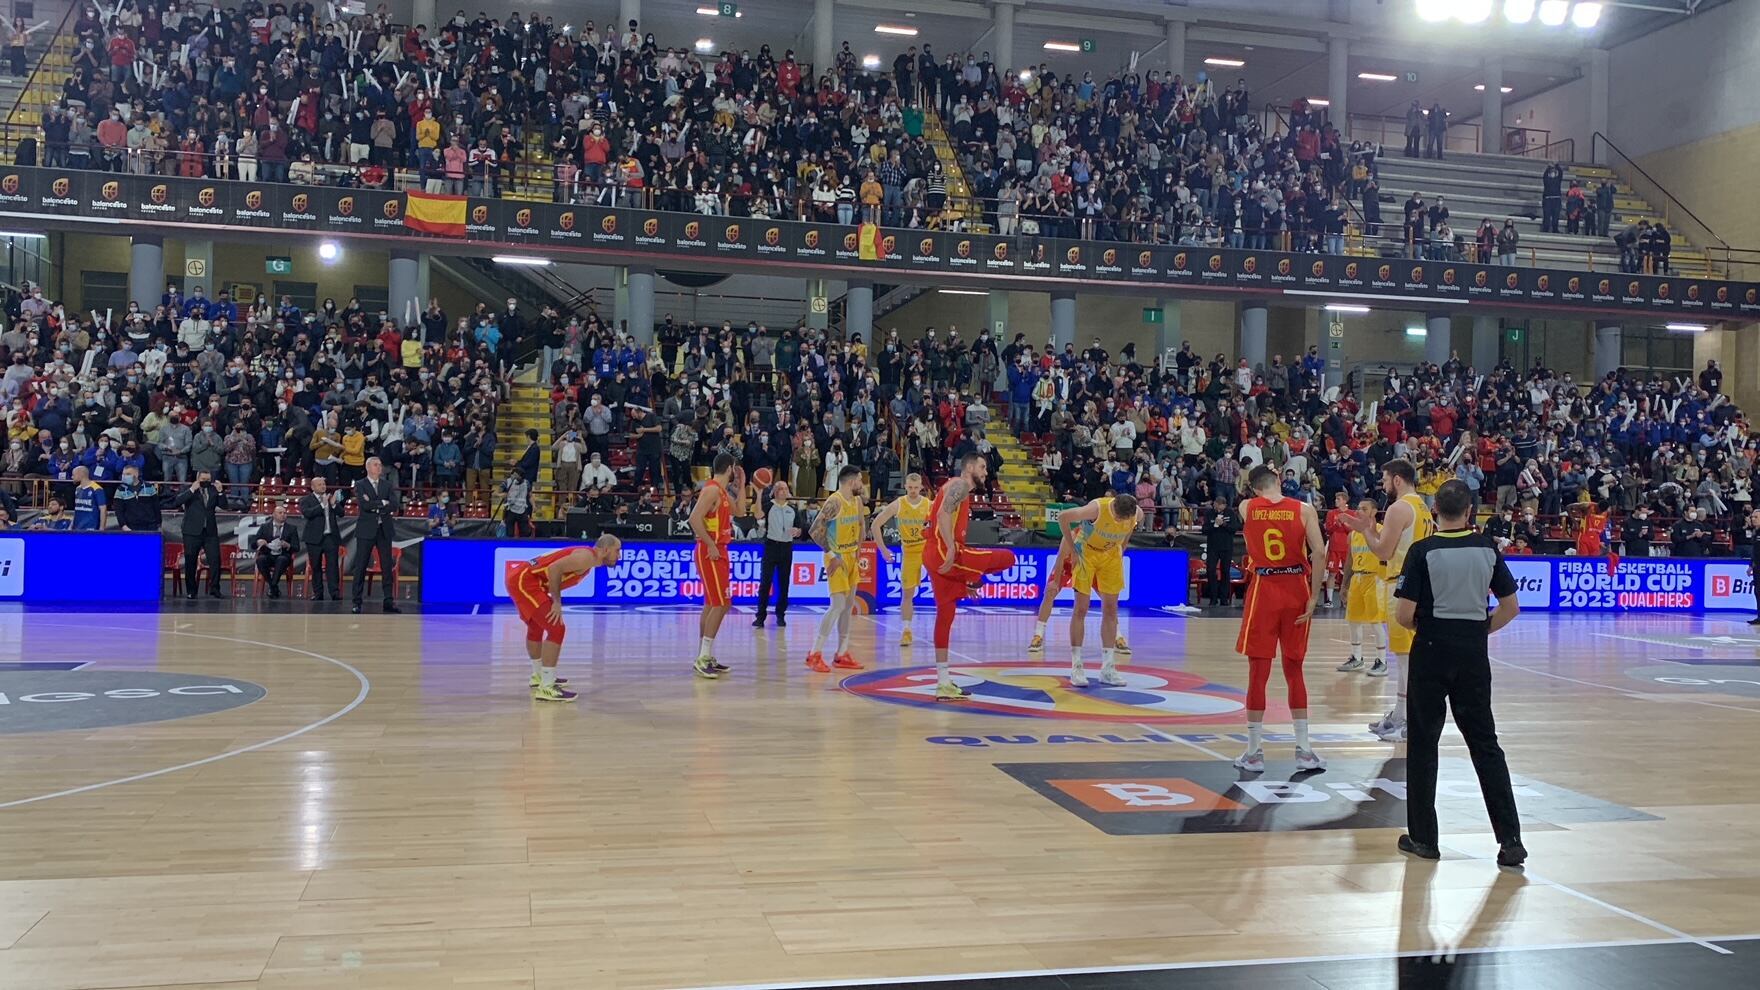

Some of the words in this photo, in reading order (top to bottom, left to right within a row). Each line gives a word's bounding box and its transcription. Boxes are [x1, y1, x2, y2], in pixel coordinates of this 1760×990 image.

[724, 4, 731, 14] 8
[1084, 40, 1091, 50] 9
[1408, 72, 1416, 82] 10
[273, 260, 284, 272] G
[1512, 330, 1518, 340] J
[910, 528, 918, 537] 32
[1264, 528, 1286, 560] 6
[1559, 562, 1593, 573] FIBA
[1559, 574, 1640, 590] WORLD
[1646, 574, 1692, 591] CUP
[606, 580, 678, 597] 2023
[1559, 591, 1616, 608] 2023
[1620, 592, 1692, 610] QUALIFIERS
